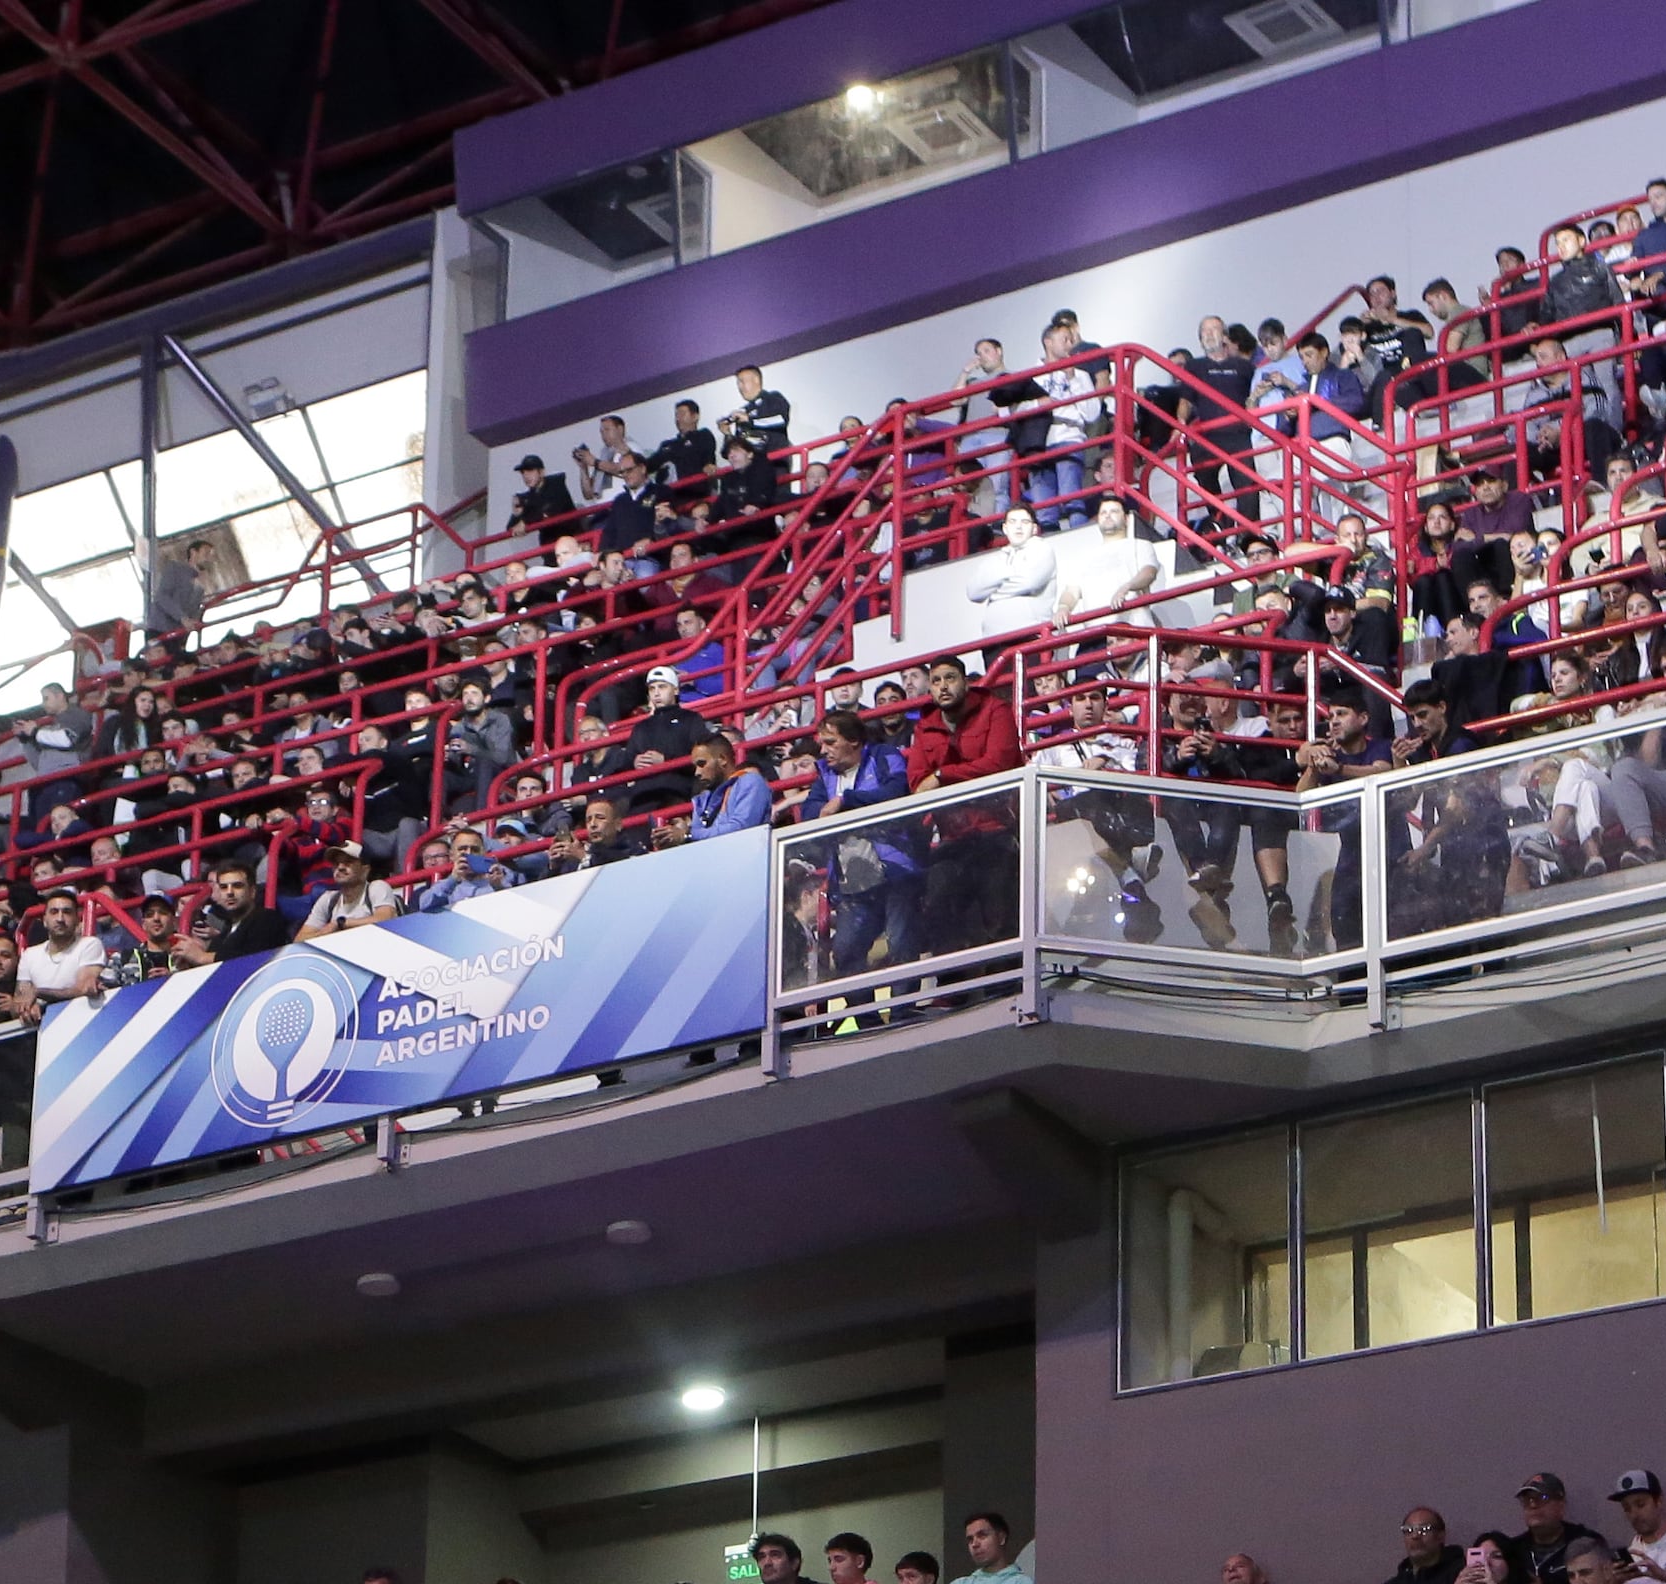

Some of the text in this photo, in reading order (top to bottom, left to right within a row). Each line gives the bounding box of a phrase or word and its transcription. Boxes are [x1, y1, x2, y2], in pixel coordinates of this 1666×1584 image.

[377, 935, 564, 1002] ASOCIACIÓN
[375, 1005, 550, 1067] ARGENTINO
[377, 992, 471, 1034] PADEL
